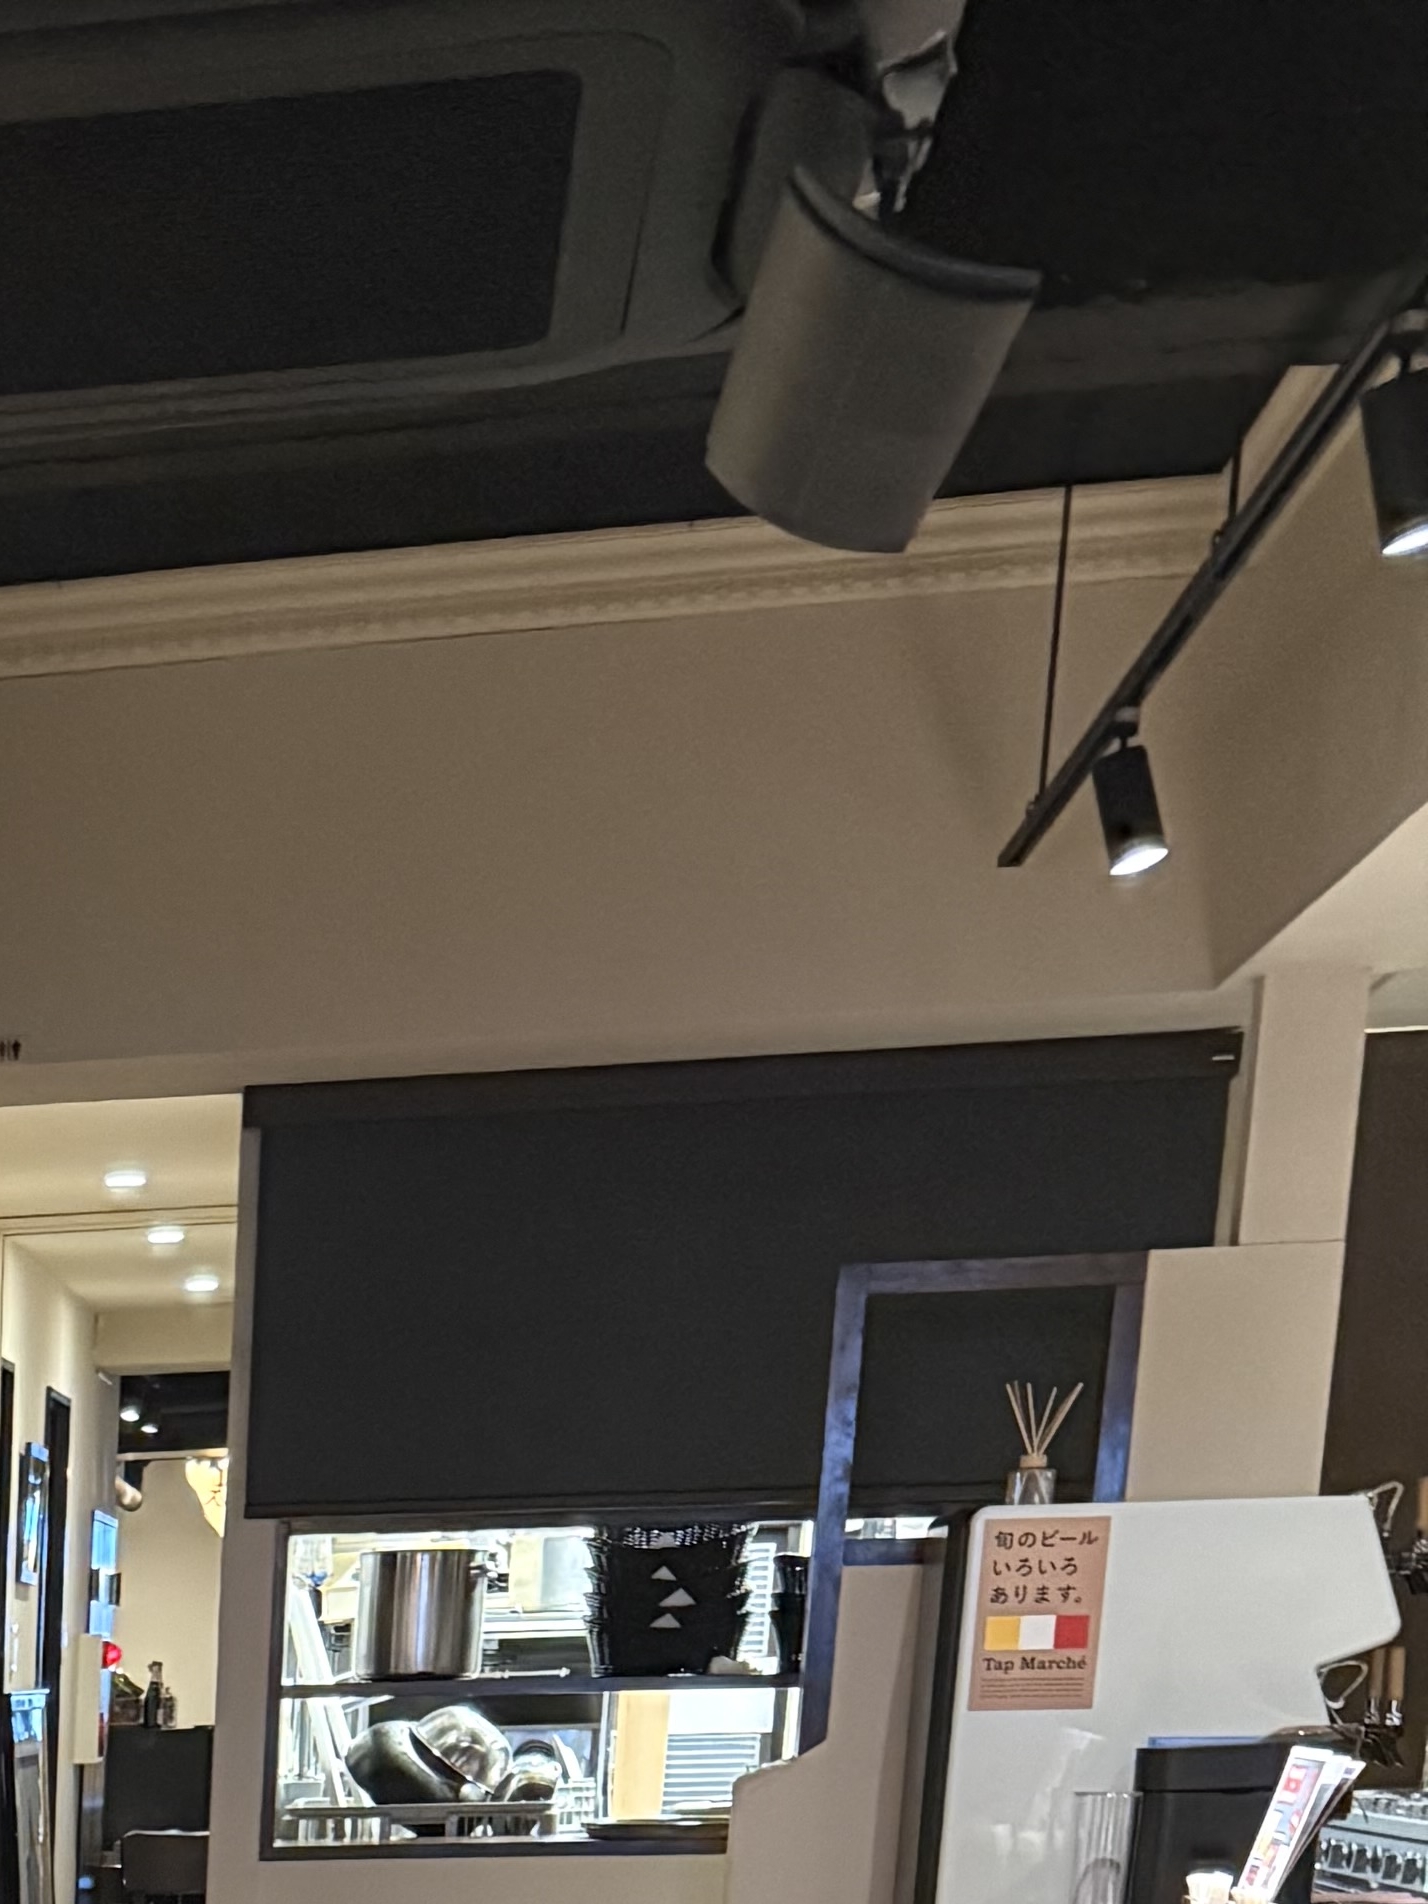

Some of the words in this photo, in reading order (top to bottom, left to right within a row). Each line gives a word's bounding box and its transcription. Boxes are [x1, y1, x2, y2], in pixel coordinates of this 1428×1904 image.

[994, 1529, 1100, 1550] 旬のビール
[992, 1556, 1079, 1577] いろいろ
[990, 1584, 1083, 1605] あります。
[982, 1657, 1015, 1674] Tap
[1019, 1655, 1088, 1671] Marché
